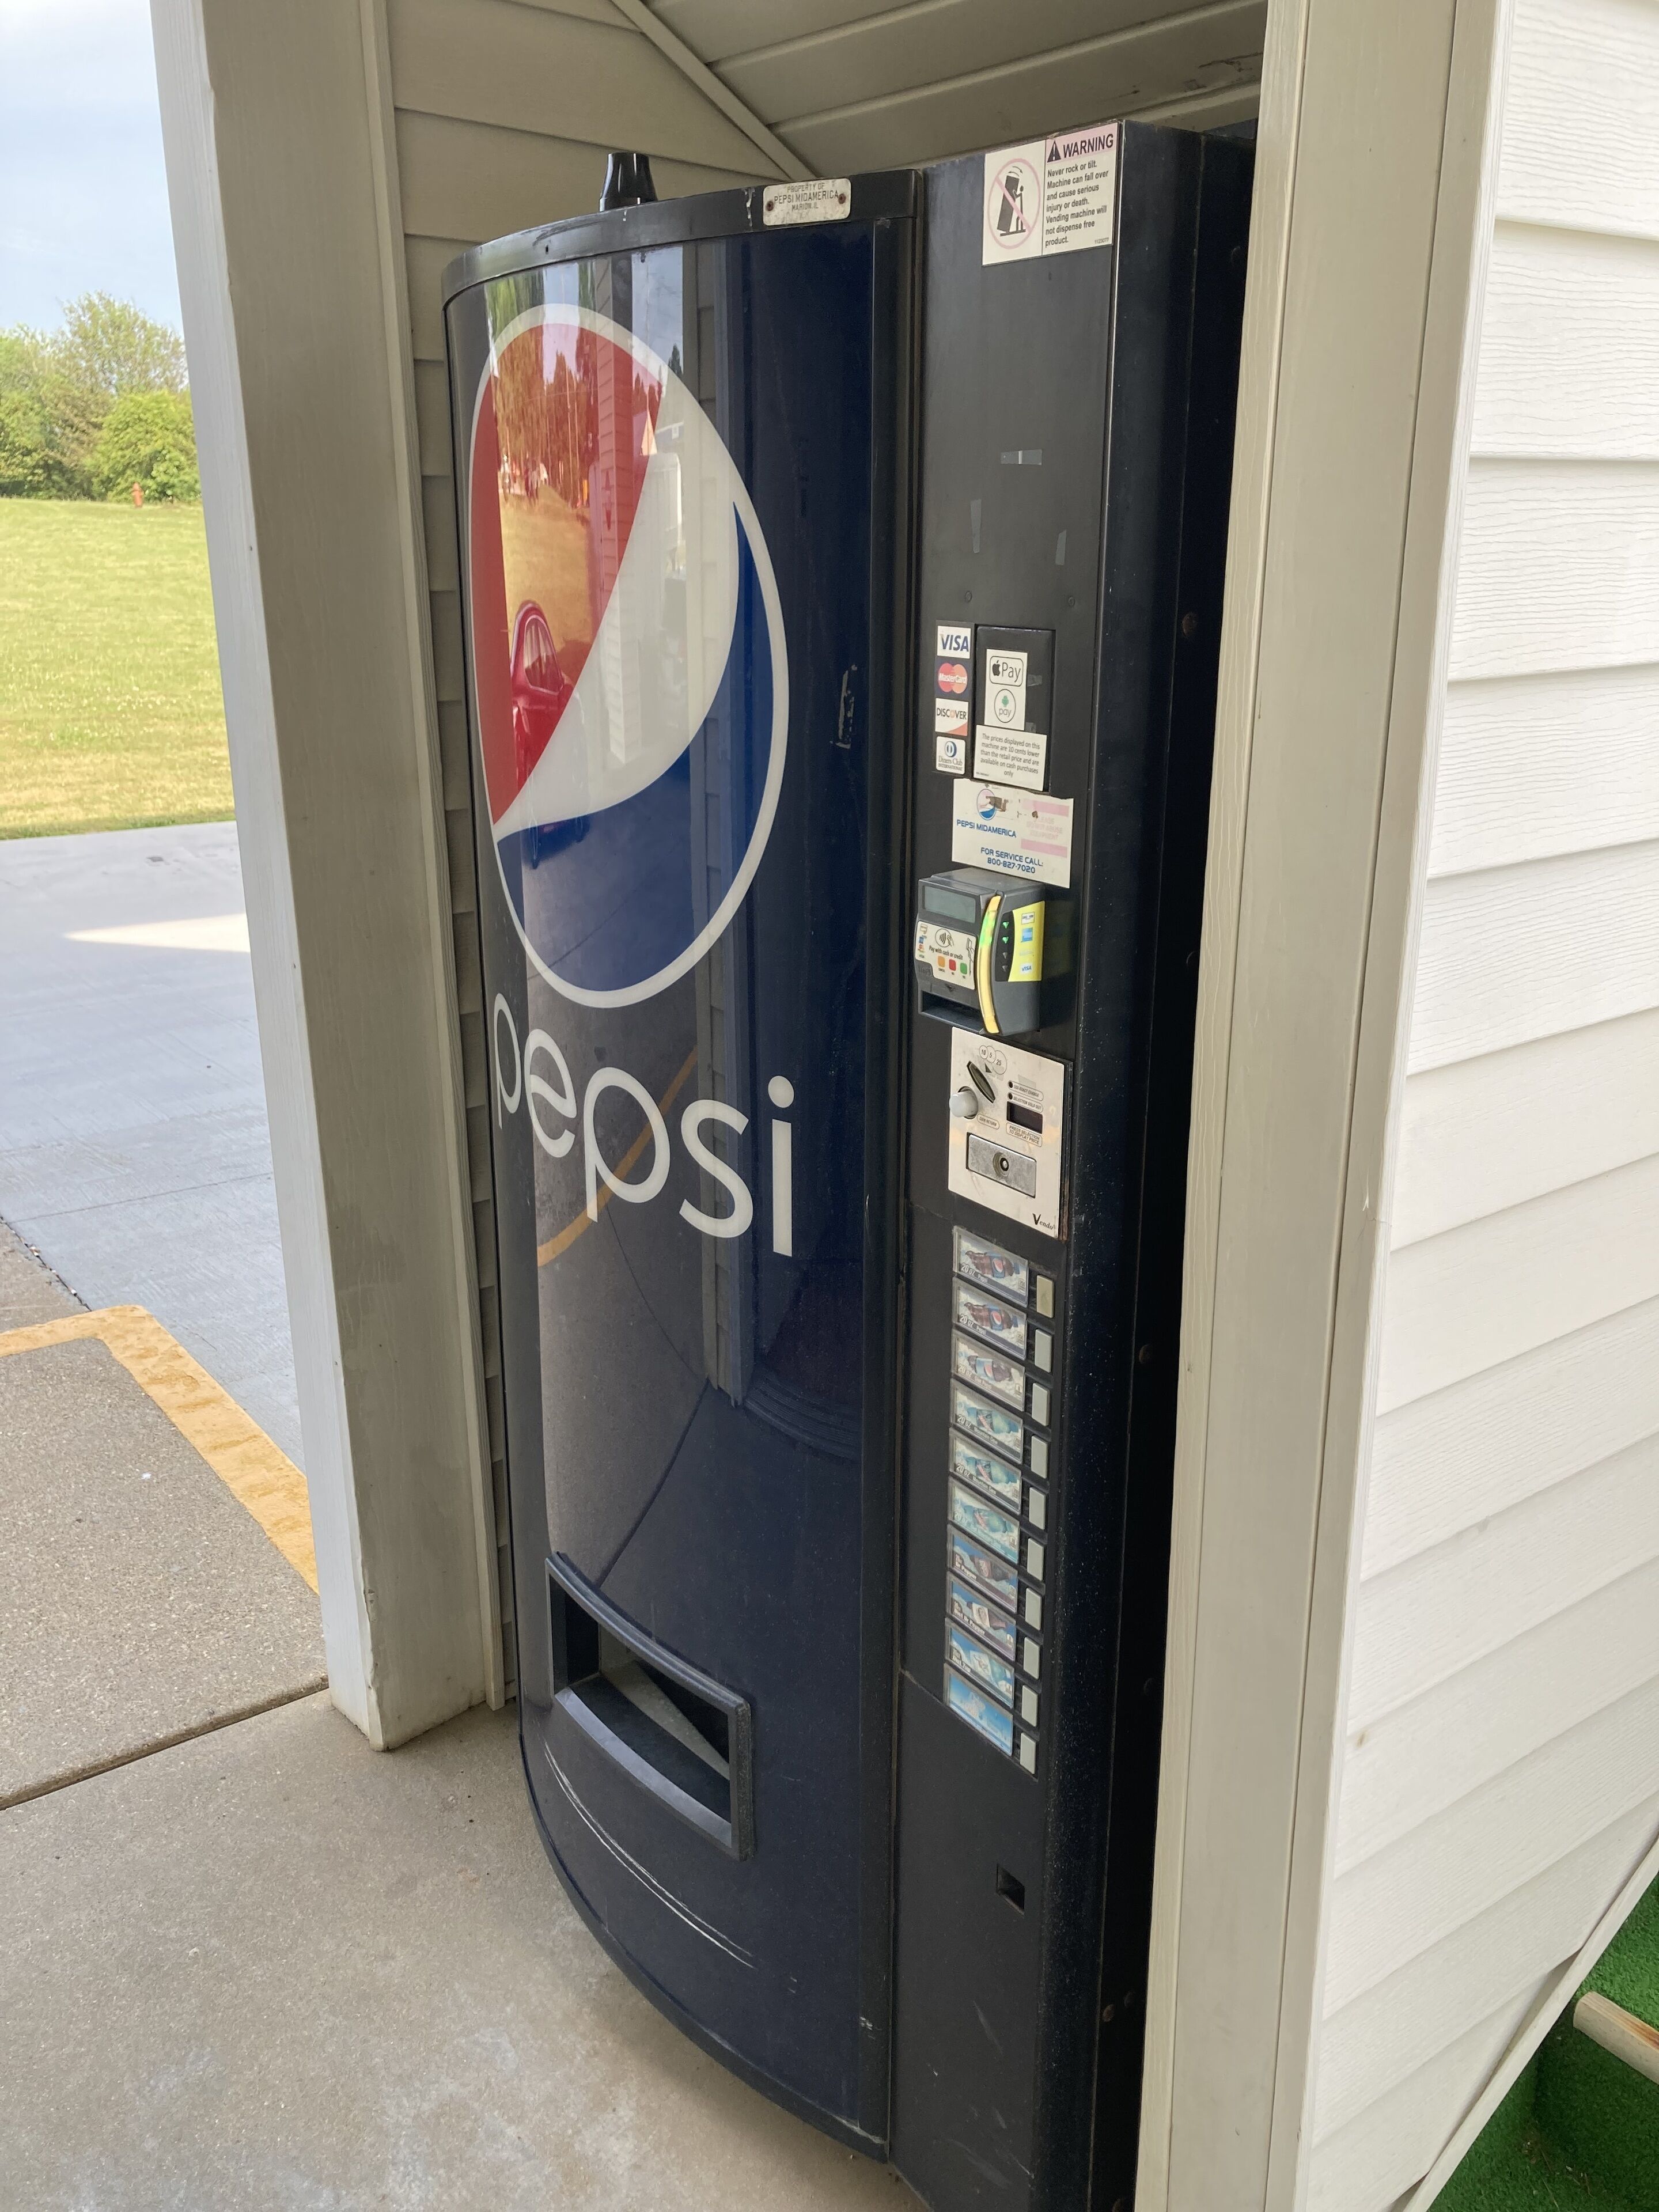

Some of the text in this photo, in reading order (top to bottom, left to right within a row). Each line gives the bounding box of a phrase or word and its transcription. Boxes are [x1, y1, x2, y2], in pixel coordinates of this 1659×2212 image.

[1063, 134, 1113, 158] WARNING
[1048, 168, 1064, 177] Never
[1066, 164, 1078, 173] rock
[1088, 160, 1097, 169] tilt.
[1047, 178, 1071, 189] Machine
[1085, 172, 1093, 181] fall
[1095, 171, 1109, 179] over
[787, 184, 815, 193] PROPERTY
[1047, 184, 1099, 200] and cause serious
[774, 190, 839, 204] PEPSI MIDAMERICA
[1046, 203, 1062, 213] injury
[1071, 197, 1089, 207] death.
[1046, 205, 1107, 224] Vending machine will
[1056, 222, 1082, 233] dispense
[1084, 220, 1095, 229] free
[1045, 236, 1069, 248] product.
[940, 634, 969, 652] VISA
[938, 673, 967, 684] MasterCard
[1002, 662, 1021, 683] Pay
[937, 707, 967, 720] DISCOVER
[999, 708, 1012, 718] pay
[1004, 737, 1025, 747] displayed
[1027, 749, 1040, 757] lower
[980, 758, 999, 766] available
[1017, 764, 1039, 774] purchases
[957, 819, 1017, 838] PEPSI MIDAMERICA
[981, 847, 1043, 866] FOR SERVICE CALL:
[987, 857, 1035, 873] 800-827-7020
[1014, 1096, 1028, 1105] SELECTION
[494, 993, 794, 1257] pepsi
[1014, 1130, 1028, 1140] DISPLAY
[1021, 1129, 1040, 1141] SELECTION
[1032, 1213, 1054, 1230] Vendo
[961, 1263, 969, 1274] 20
[960, 1315, 968, 1324] 20
[957, 1414, 965, 1424] 20
[956, 1464, 964, 1474] 20
